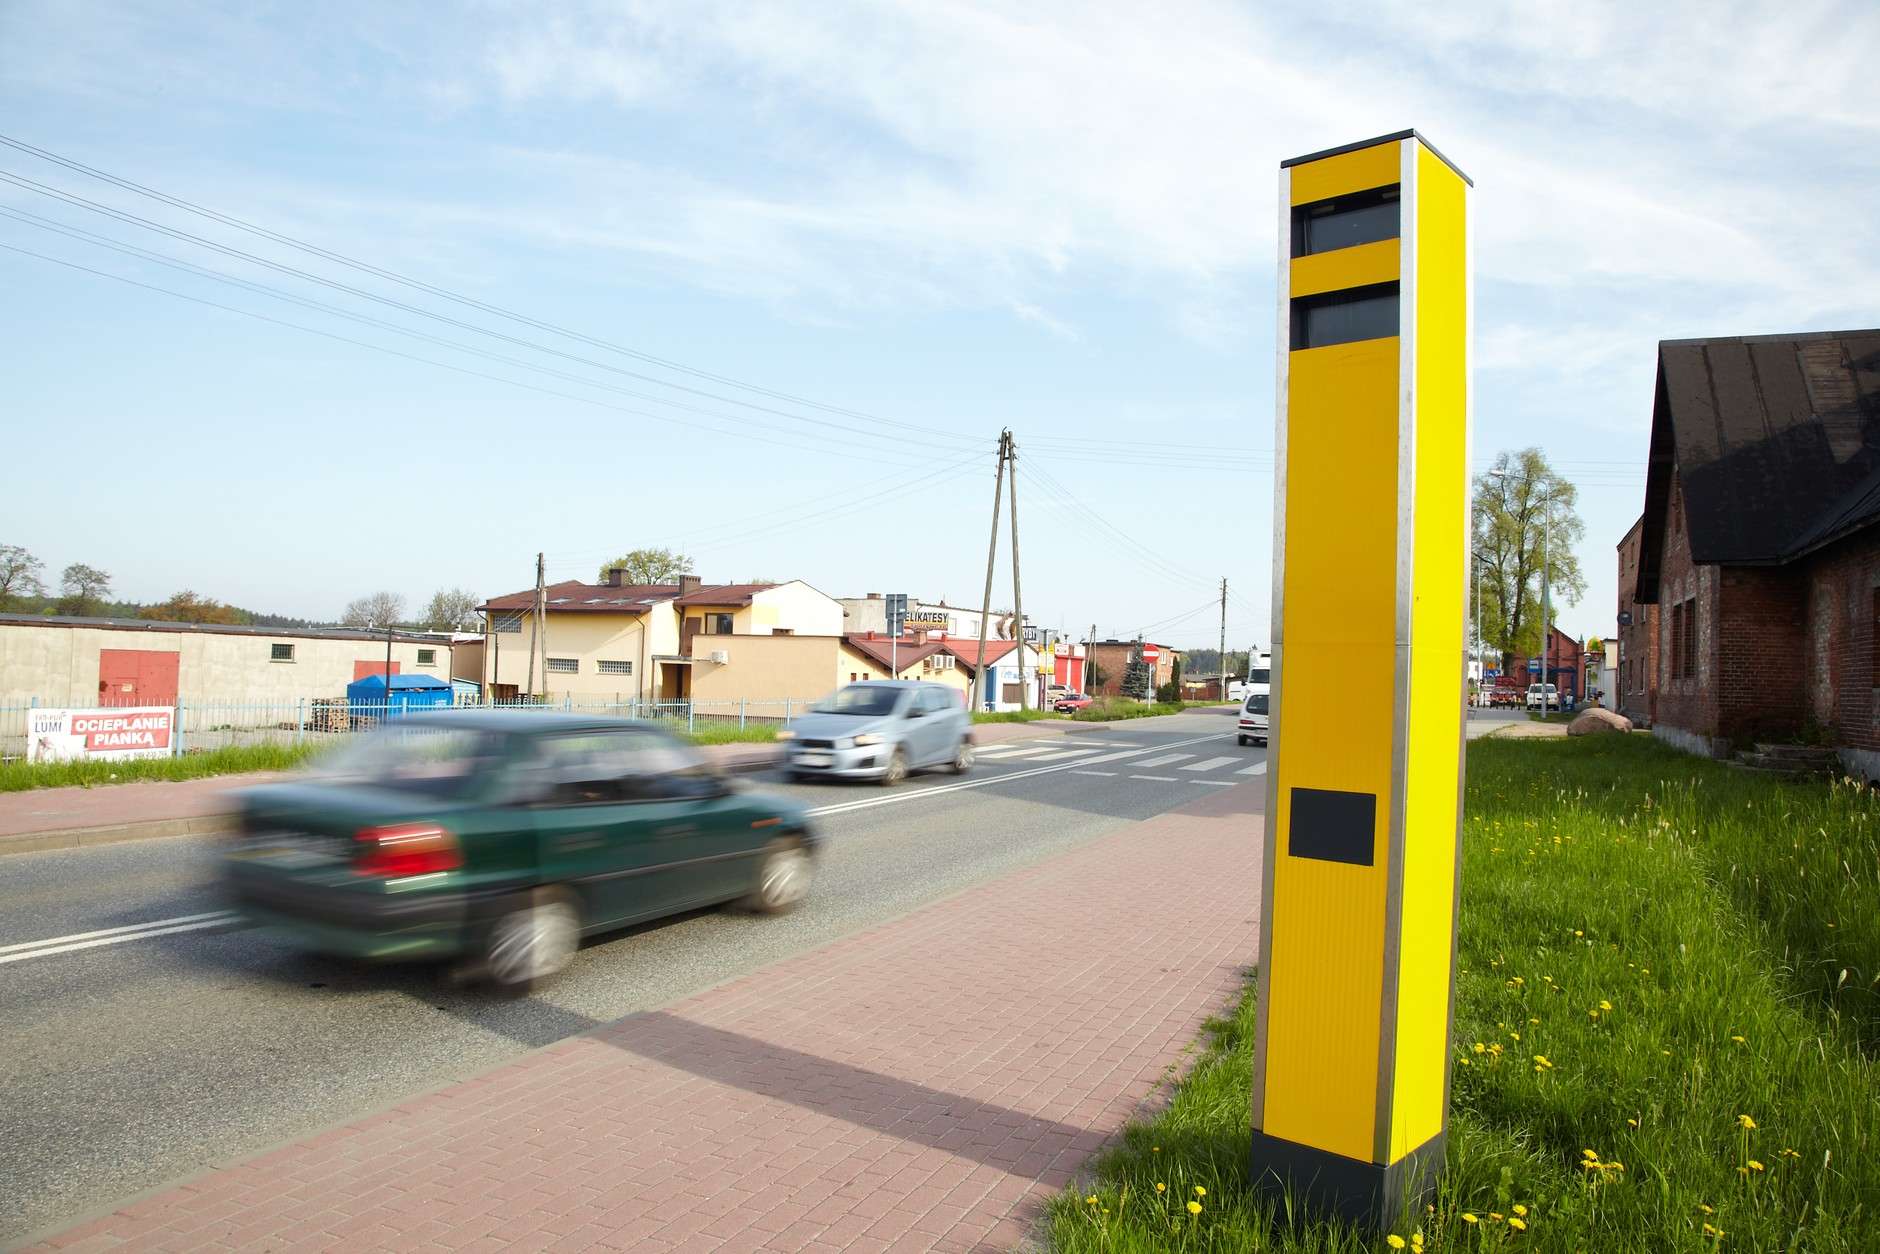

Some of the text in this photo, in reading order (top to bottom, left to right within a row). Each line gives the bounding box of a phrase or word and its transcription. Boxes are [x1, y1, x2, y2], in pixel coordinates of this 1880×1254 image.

[904, 612, 949, 623] ELIKATESY
[35, 722, 62, 733] LUMI
[75, 717, 168, 731] OCIEPLANIE
[94, 732, 154, 745] PIANKĄ
